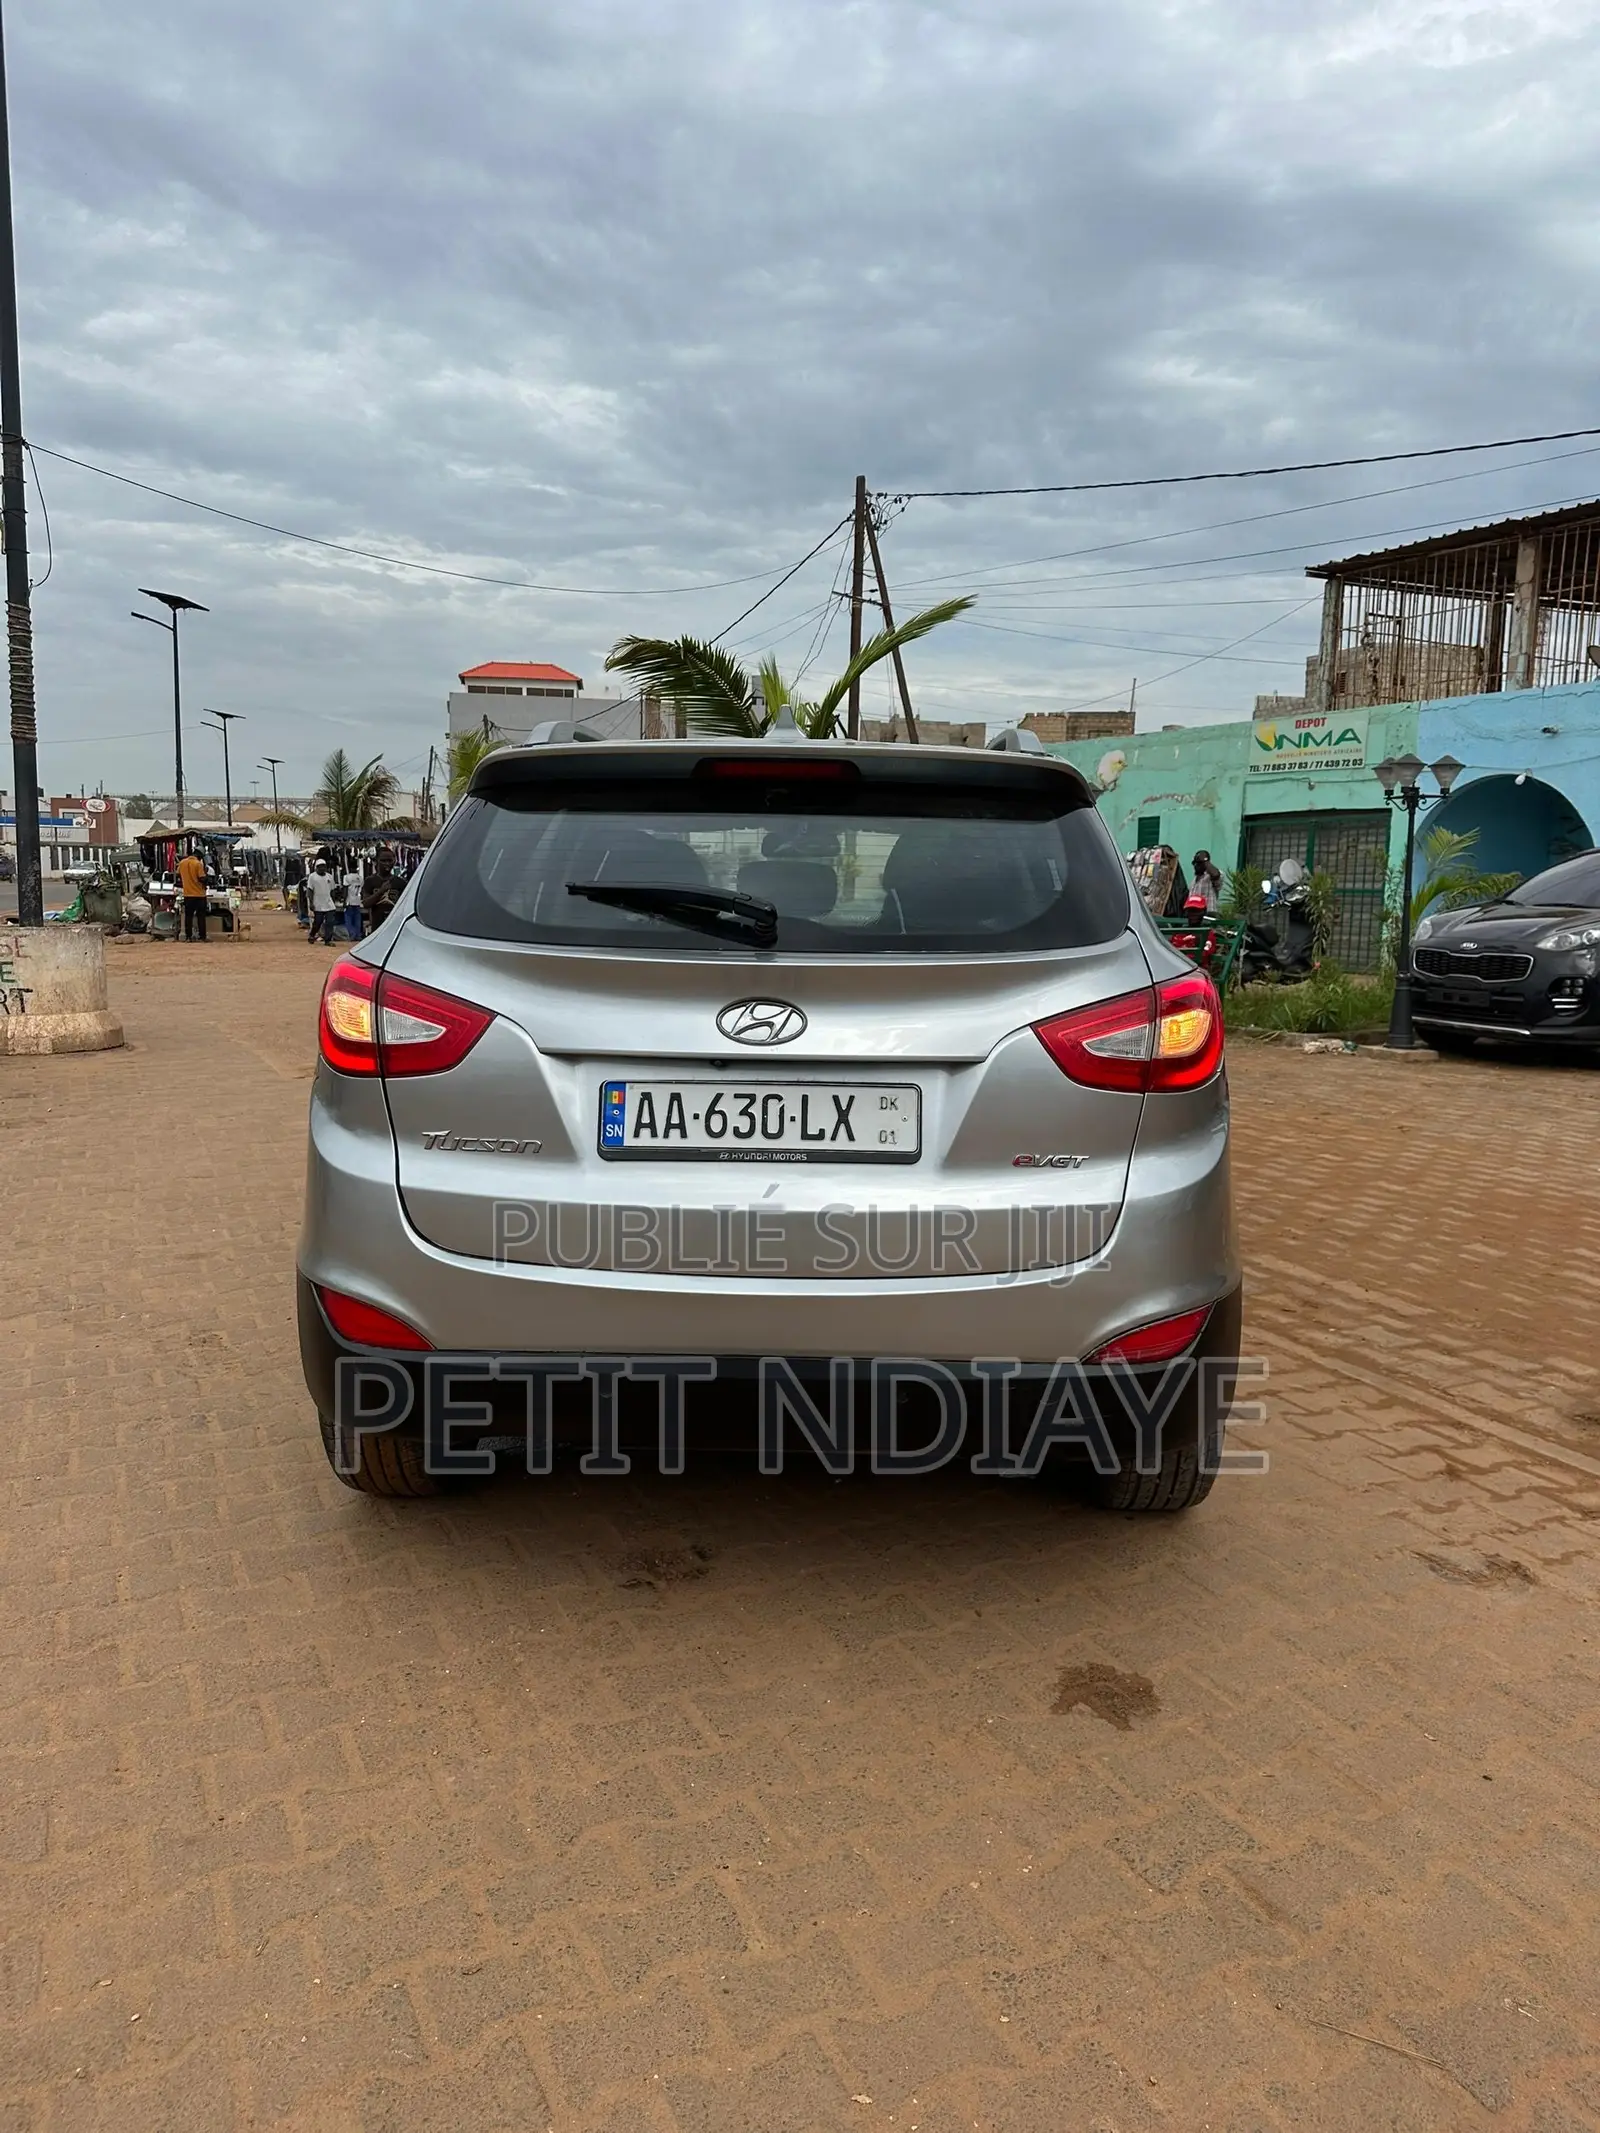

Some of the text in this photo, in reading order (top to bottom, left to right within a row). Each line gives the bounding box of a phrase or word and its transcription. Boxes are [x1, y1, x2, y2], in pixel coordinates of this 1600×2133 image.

[1295, 717, 1327, 729] DEPOT
[1315, 760, 1323, 769] 77
[1324, 759, 1340, 768] 439
[1341, 759, 1351, 767] 72
[878, 1096, 899, 1111] DK
[605, 1124, 623, 1138] SN
[878, 1129, 898, 1145] 01
[421, 1129, 543, 1154] Tucson
[732, 1152, 807, 1161] HYUNDAI MOTORS
[1012, 1153, 1090, 1169] eVGT
